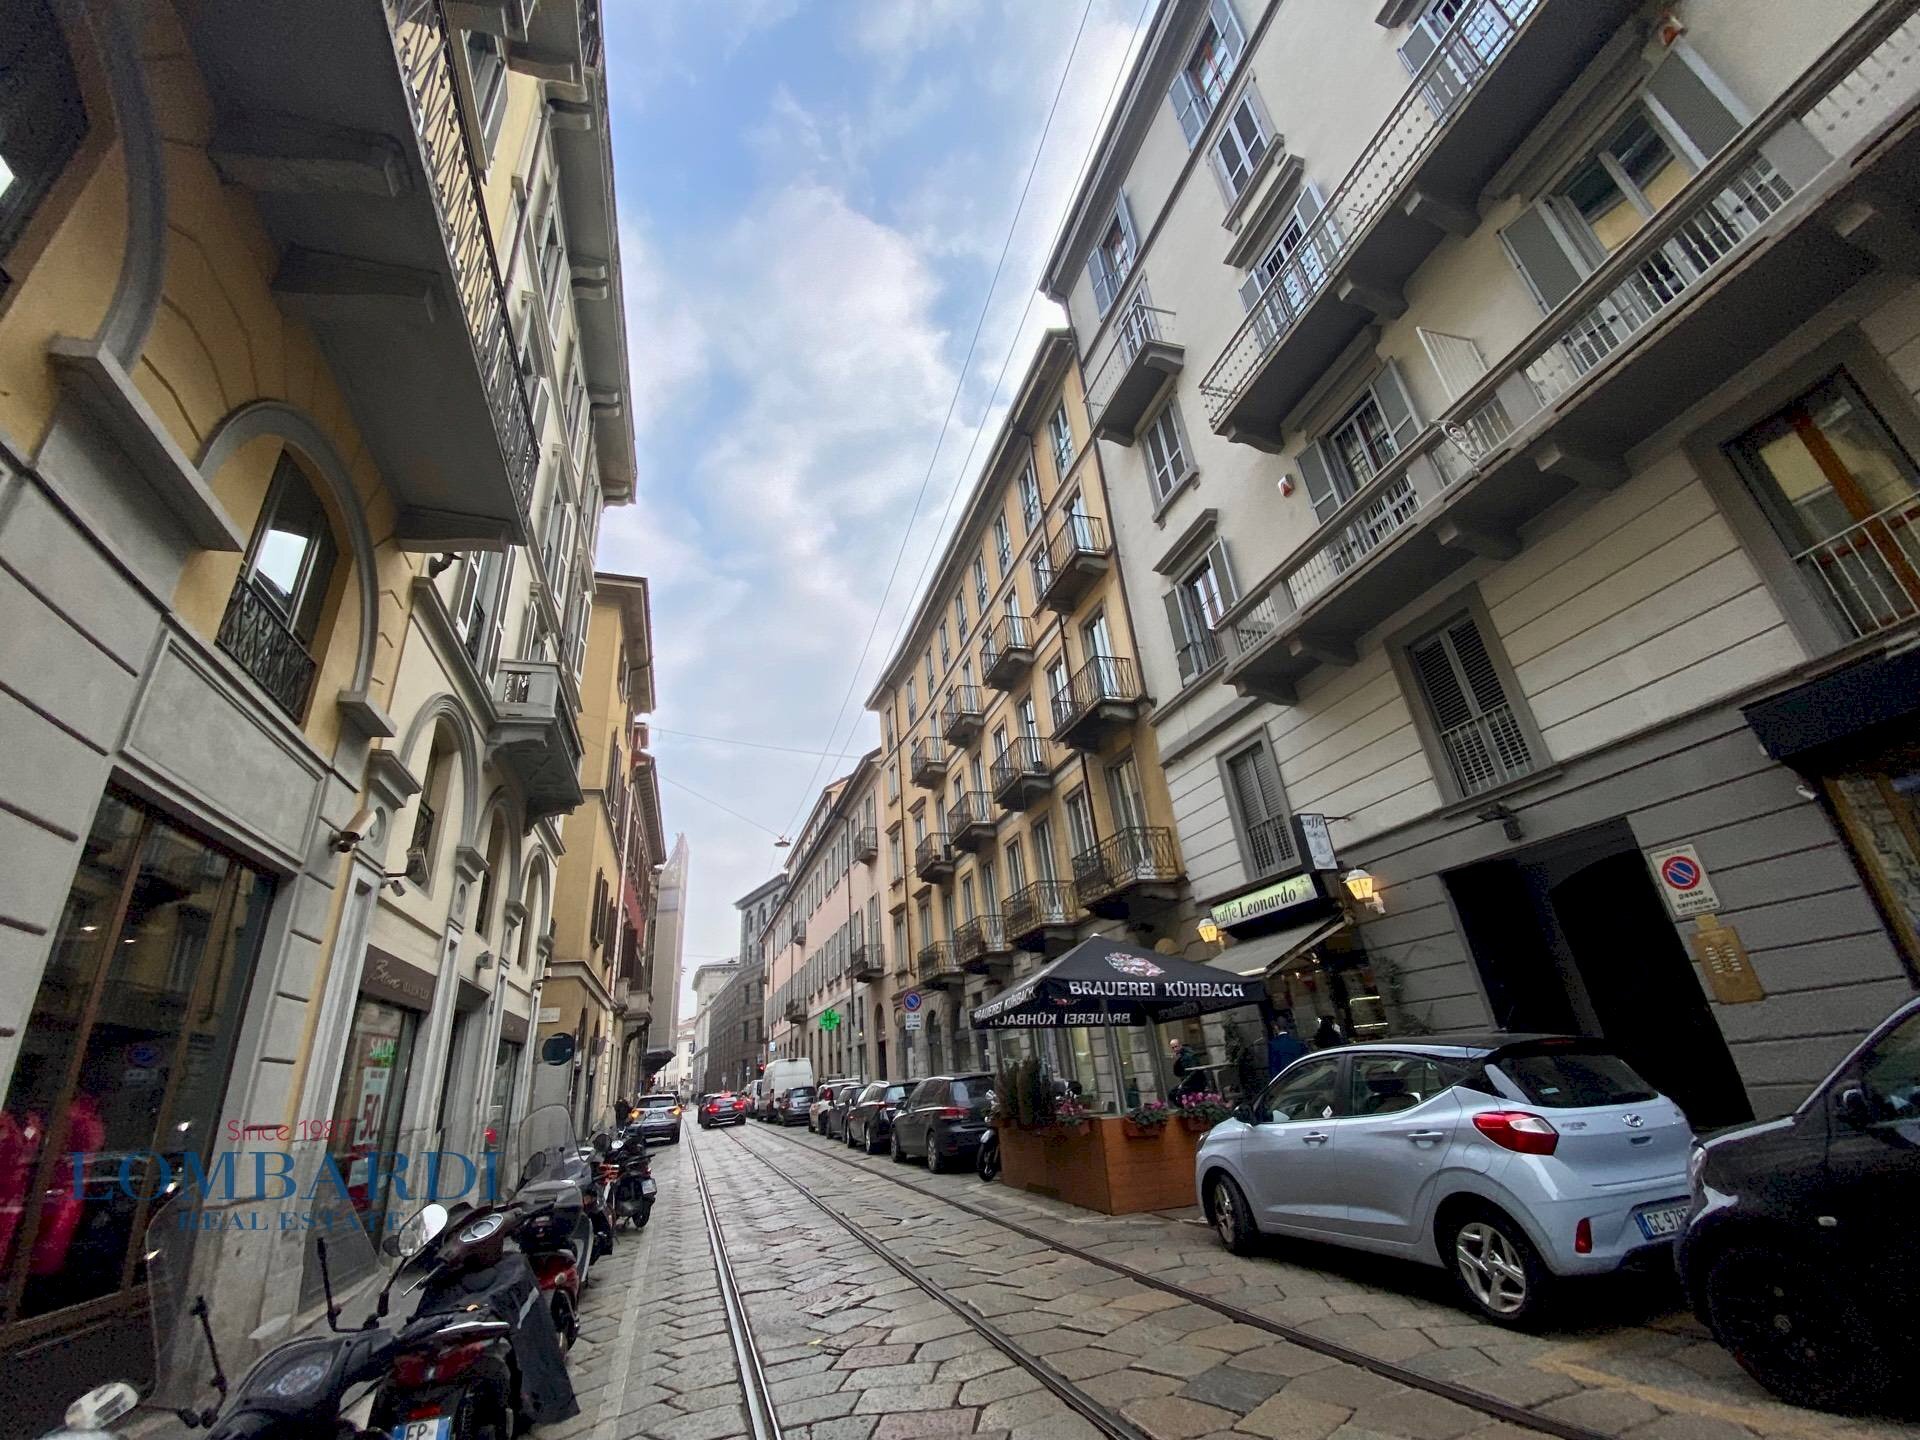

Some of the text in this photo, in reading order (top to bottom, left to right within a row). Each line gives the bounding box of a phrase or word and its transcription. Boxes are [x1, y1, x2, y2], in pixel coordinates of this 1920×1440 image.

[1239, 886, 1297, 919] Leonardo
[1069, 980, 1245, 998] BRAUEREI KÜHBACH
